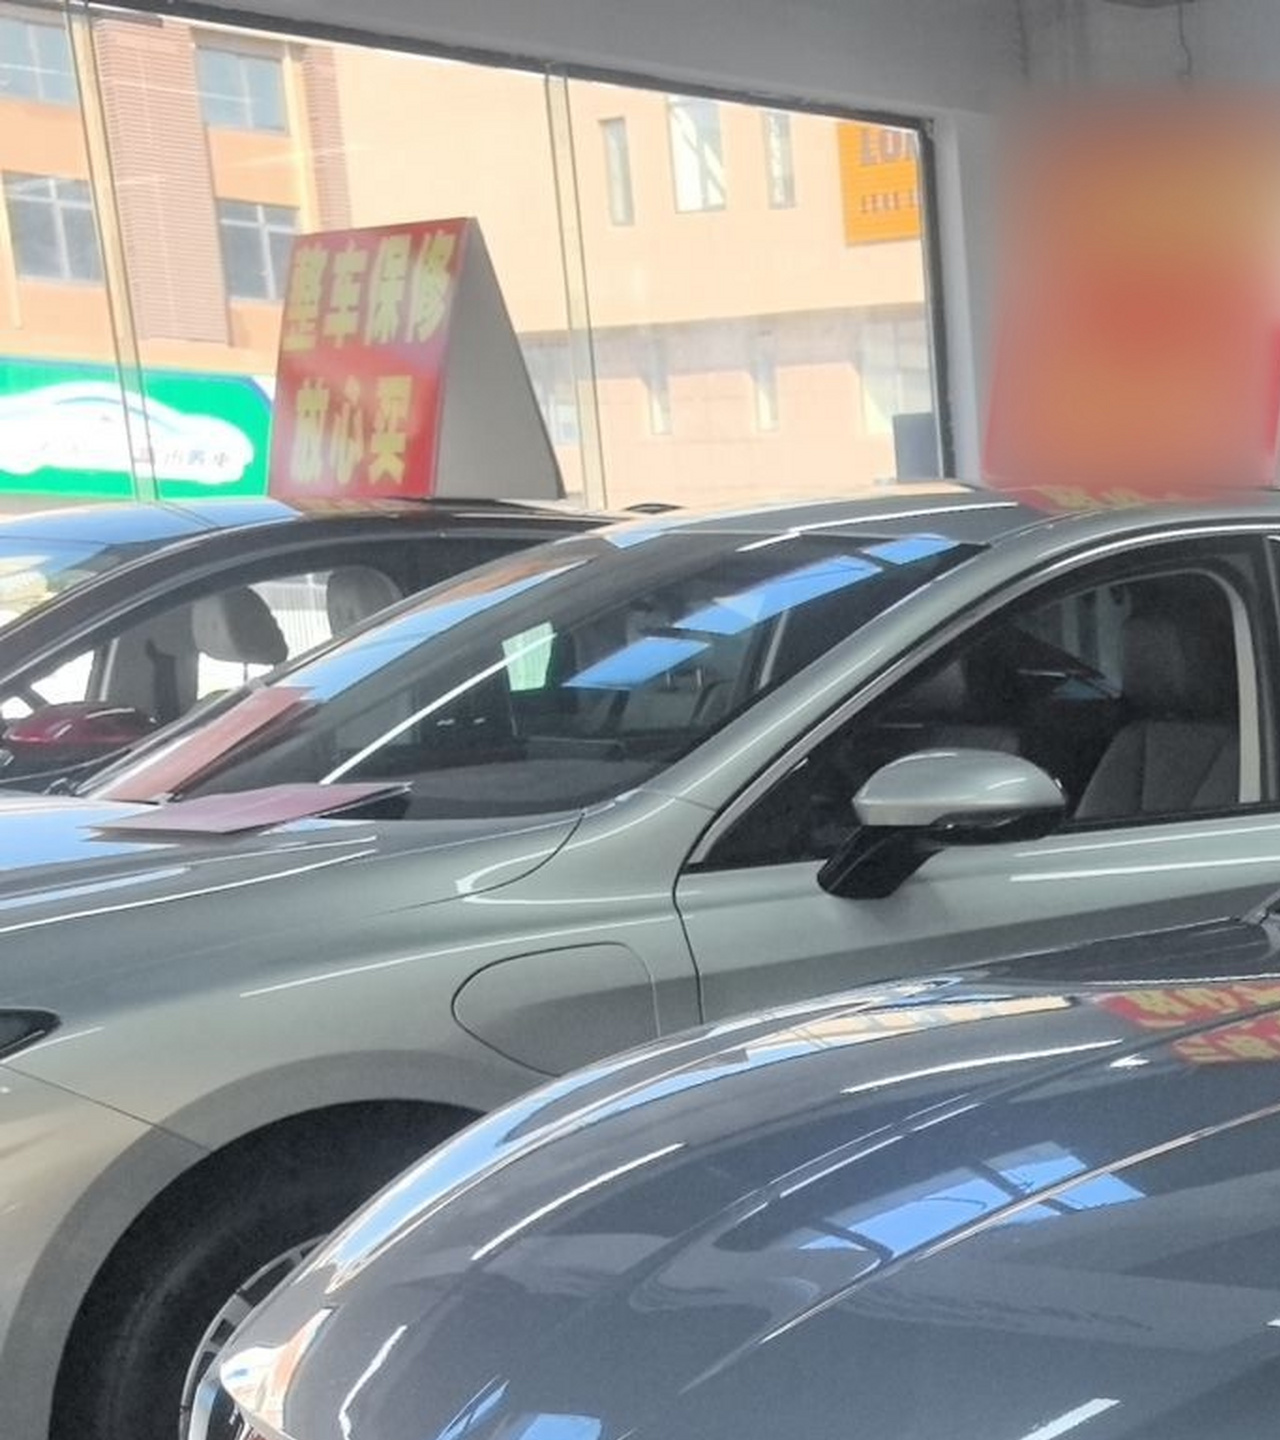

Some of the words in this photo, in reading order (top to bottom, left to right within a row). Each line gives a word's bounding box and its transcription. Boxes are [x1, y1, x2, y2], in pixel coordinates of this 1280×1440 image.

[282, 229, 456, 351] 整车保修
[290, 374, 413, 484] 放心买
